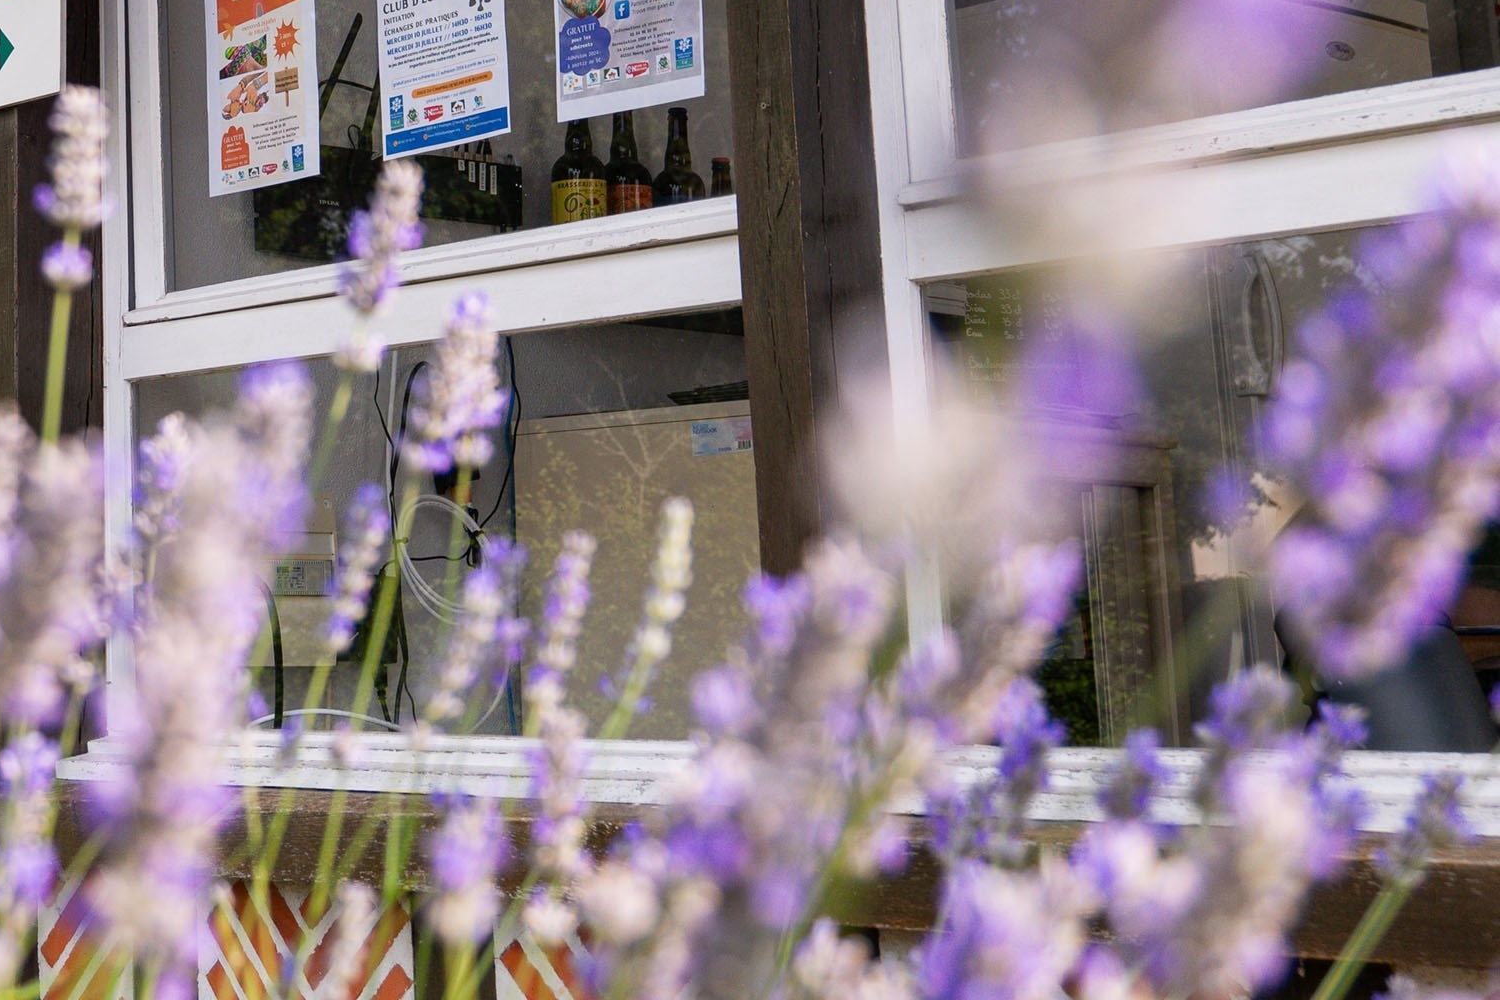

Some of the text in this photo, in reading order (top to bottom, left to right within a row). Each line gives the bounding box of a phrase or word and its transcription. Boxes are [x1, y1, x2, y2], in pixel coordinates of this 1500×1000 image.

[382, 0, 408, 14] CLUB
[383, 11, 414, 25] INITIATION
[383, 10, 458, 36] ÉCHANGES DE PRATIQUES
[386, 33, 413, 45] MERCREDI
[421, 25, 442, 37] JUILLET
[451, 18, 468, 27] 14H30
[473, 11, 492, 21] 16H30
[566, 22, 596, 35] GRATUIT
[387, 43, 413, 55] MERCREDI
[420, 35, 442, 47] JUILLET
[451, 28, 468, 37] 14H30
[474, 22, 492, 31] 16H30
[223, 133, 243, 143] GRATUIT
